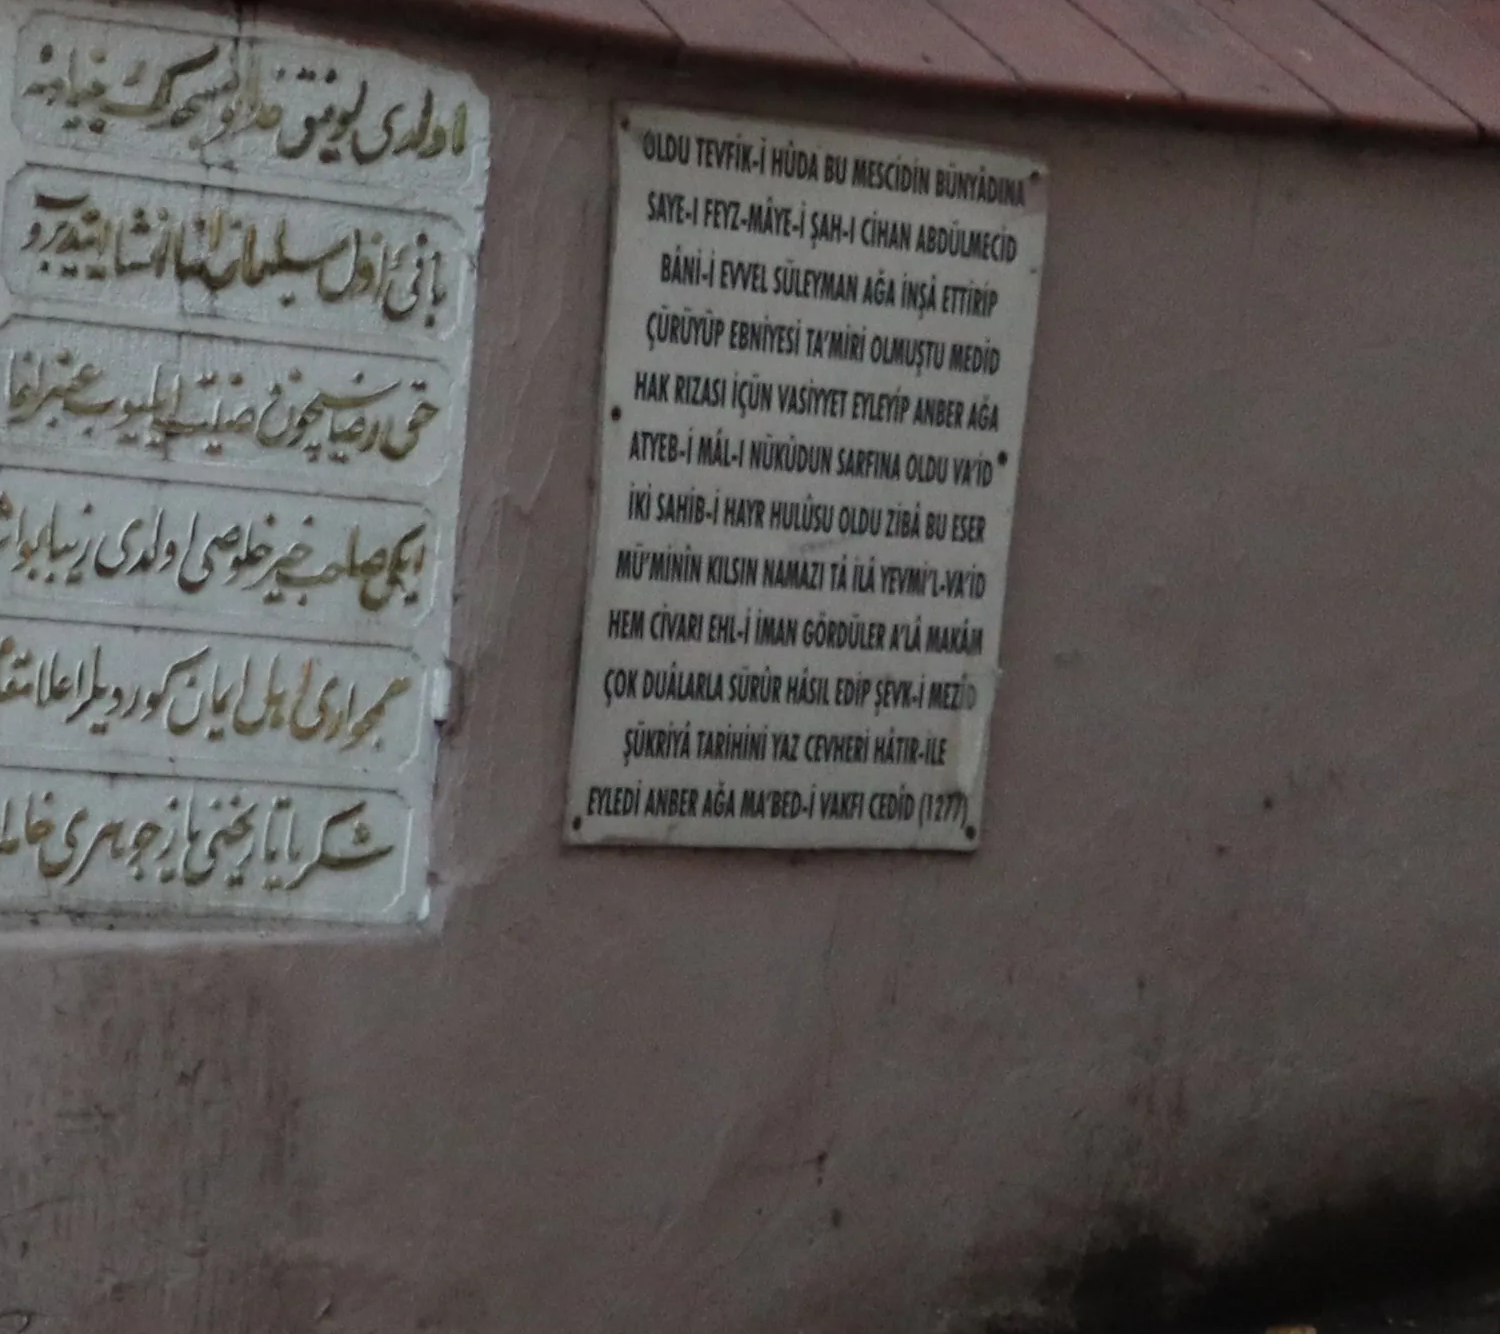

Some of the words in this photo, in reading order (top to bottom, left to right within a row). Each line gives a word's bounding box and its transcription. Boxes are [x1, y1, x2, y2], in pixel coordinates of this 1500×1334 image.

[642, 131, 690, 165] OLDU
[823, 154, 846, 184] BU
[647, 190, 698, 225] SAYE-I
[719, 259, 768, 293] EVVEL
[633, 370, 670, 402] HAK
[673, 374, 727, 407] RIZASI
[912, 397, 964, 428] ANBER
[835, 447, 900, 480] SARFINA
[905, 452, 948, 484] OLDU
[722, 496, 765, 528] HAYR
[838, 505, 882, 536] OLDU
[924, 511, 947, 541] BU
[951, 513, 986, 543] ESER
[706, 555, 758, 586] KILSIN
[761, 558, 824, 590] NAMAZI
[607, 609, 645, 639] HEM
[771, 732, 800, 762] YAZ
[644, 787, 698, 816] ANBER
[819, 791, 864, 819] VAKFI
